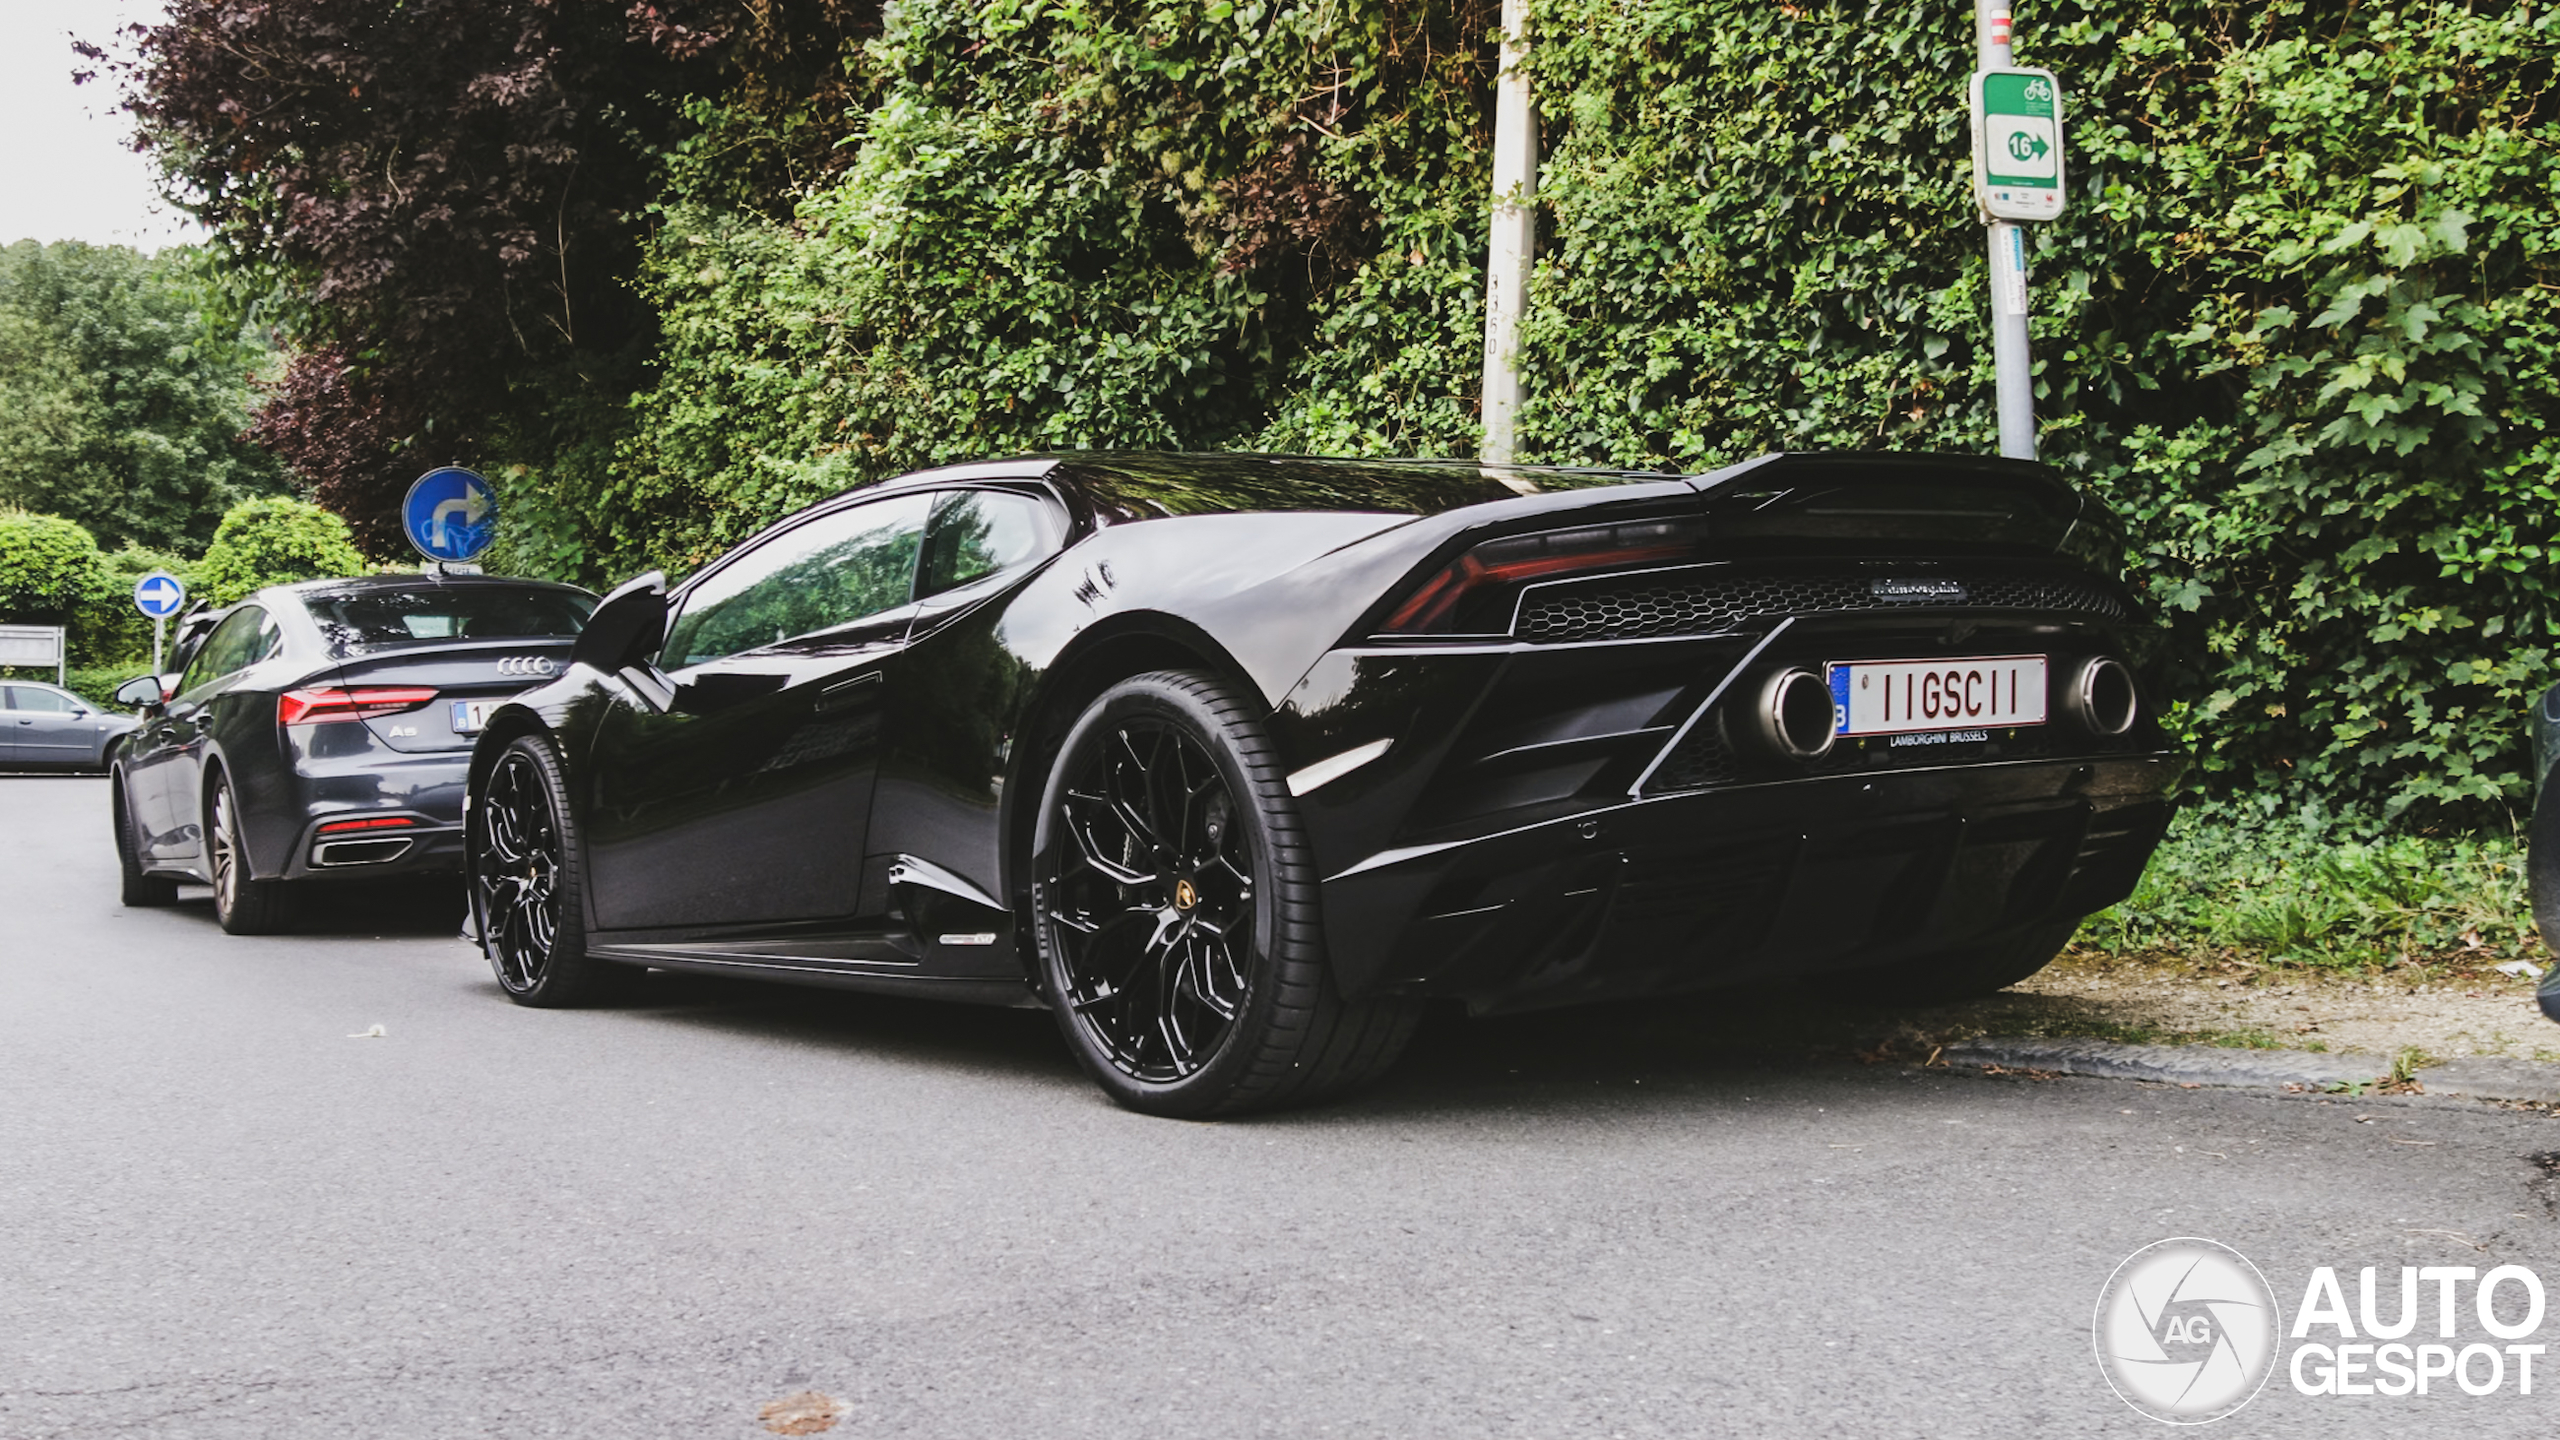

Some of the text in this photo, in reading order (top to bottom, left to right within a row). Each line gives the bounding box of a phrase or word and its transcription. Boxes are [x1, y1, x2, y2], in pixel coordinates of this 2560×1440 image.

[2009, 135, 2033, 157] 16
[388, 725, 418, 738] A5
[1889, 730, 1989, 748] LAMBORGHINI BRUSSELS
